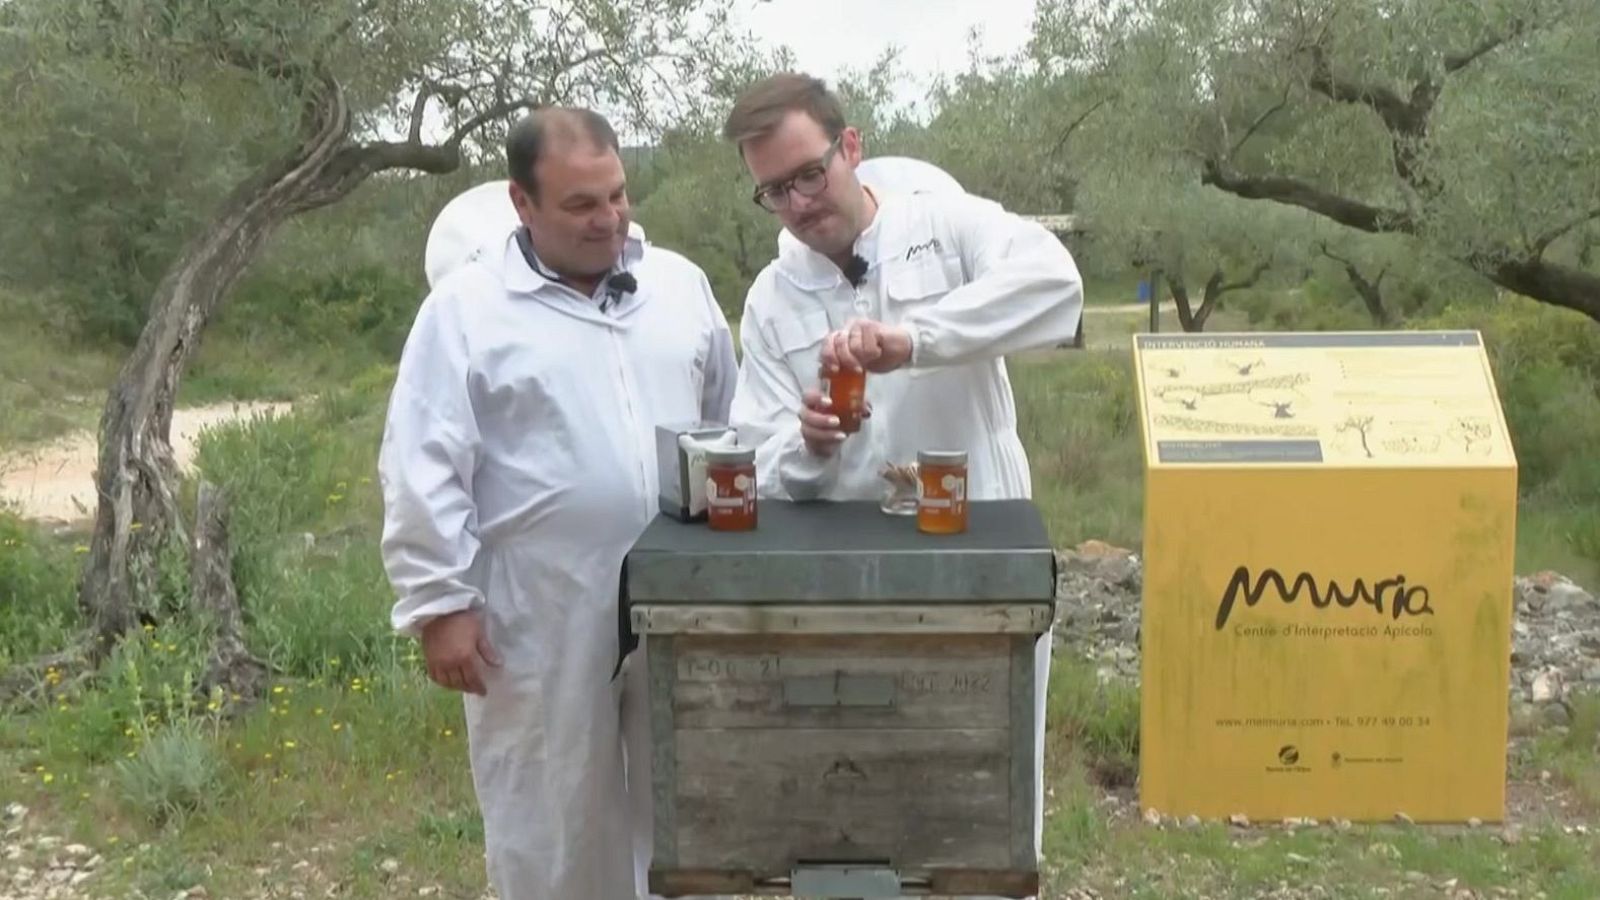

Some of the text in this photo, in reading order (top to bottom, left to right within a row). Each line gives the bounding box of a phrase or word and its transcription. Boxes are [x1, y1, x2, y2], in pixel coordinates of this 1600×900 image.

[1144, 338, 1265, 349] INTERVENCIÓ HUMANA
[1234, 625, 1277, 638] Centre
[1282, 623, 1378, 639] d'Interpretació
[1356, 715, 1378, 727] 977
[1382, 715, 1396, 727] 49
[1399, 715, 1414, 727] 00
